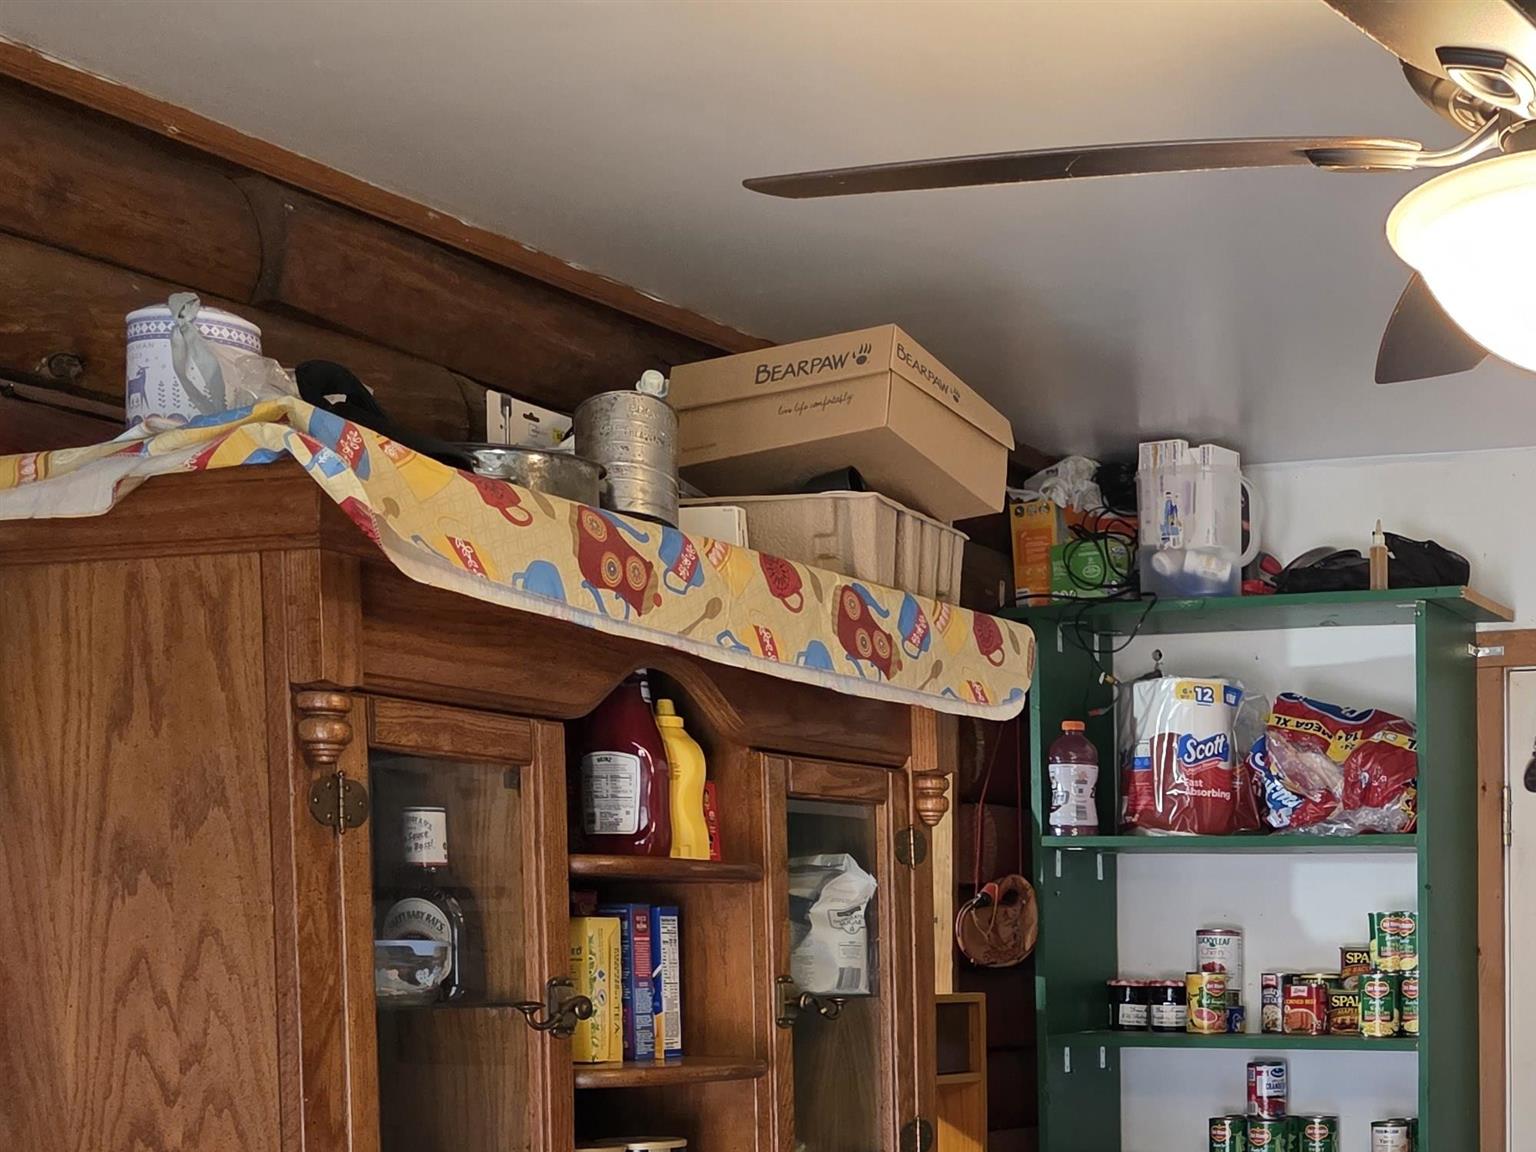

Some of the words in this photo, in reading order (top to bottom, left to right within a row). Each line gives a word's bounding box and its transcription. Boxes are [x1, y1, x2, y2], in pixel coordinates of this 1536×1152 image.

[754, 352, 849, 385] BEARPAW
[896, 343, 950, 394] BEARPAW
[1194, 686, 1214, 703] 12
[1274, 715, 1289, 727] XL
[1295, 715, 1333, 741] MEGA
[1184, 733, 1227, 762] Scott
[1184, 788, 1232, 801] Absorbing
[1345, 952, 1371, 964] SPA
